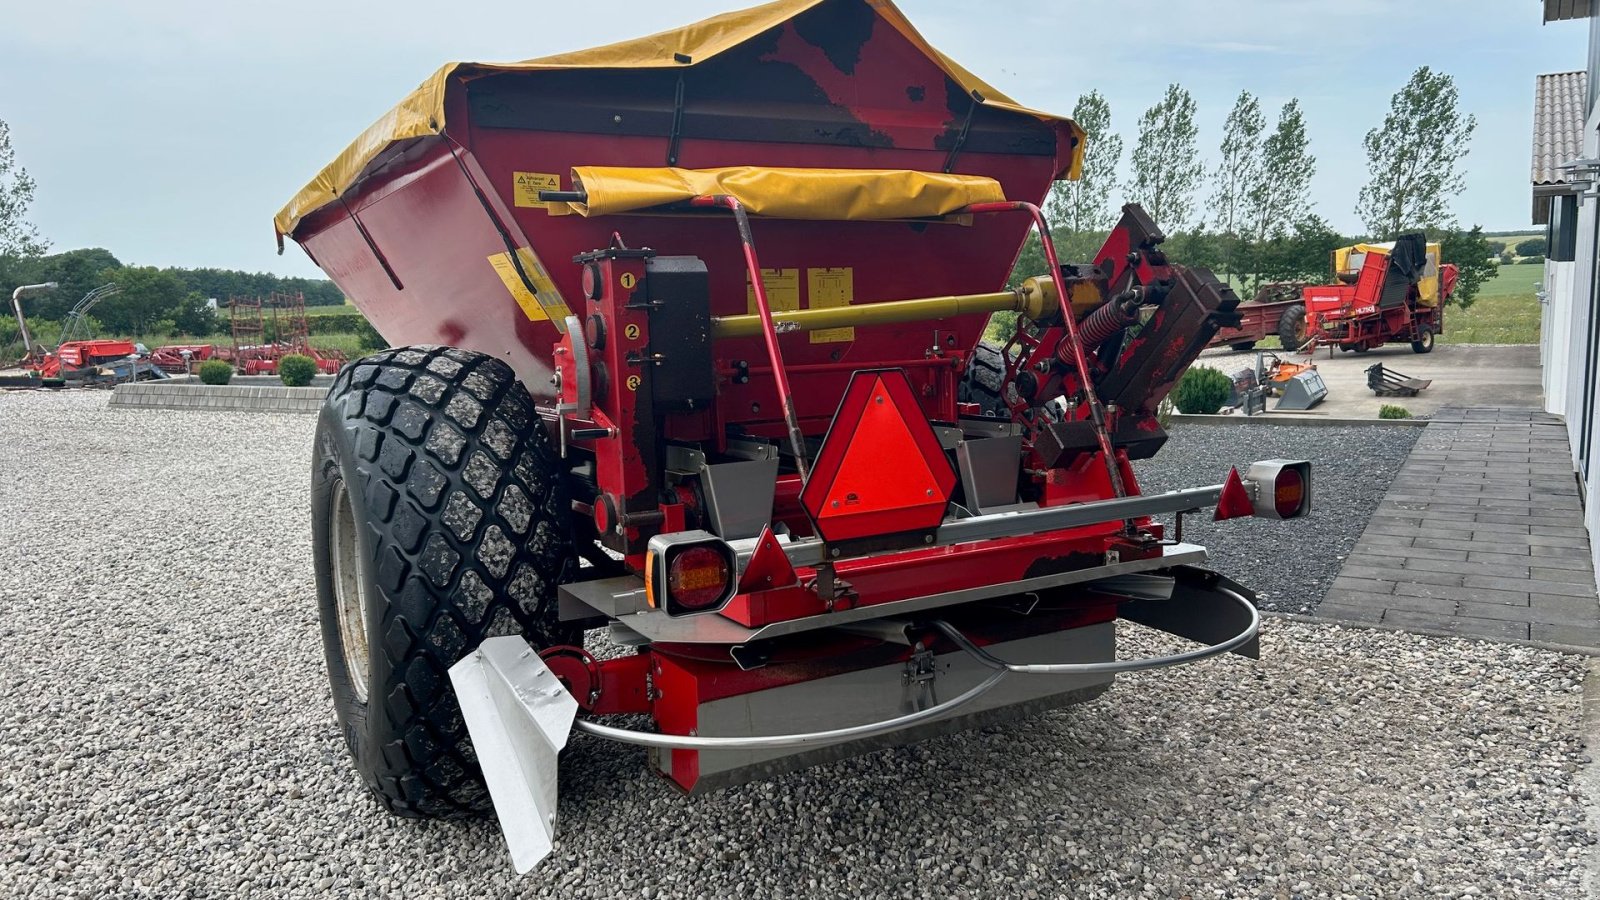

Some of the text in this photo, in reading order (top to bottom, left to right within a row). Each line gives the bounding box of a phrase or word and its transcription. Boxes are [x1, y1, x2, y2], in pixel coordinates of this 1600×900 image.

[625, 275, 630, 286] 1
[629, 326, 636, 338] 2
[630, 376, 638, 389] 3
